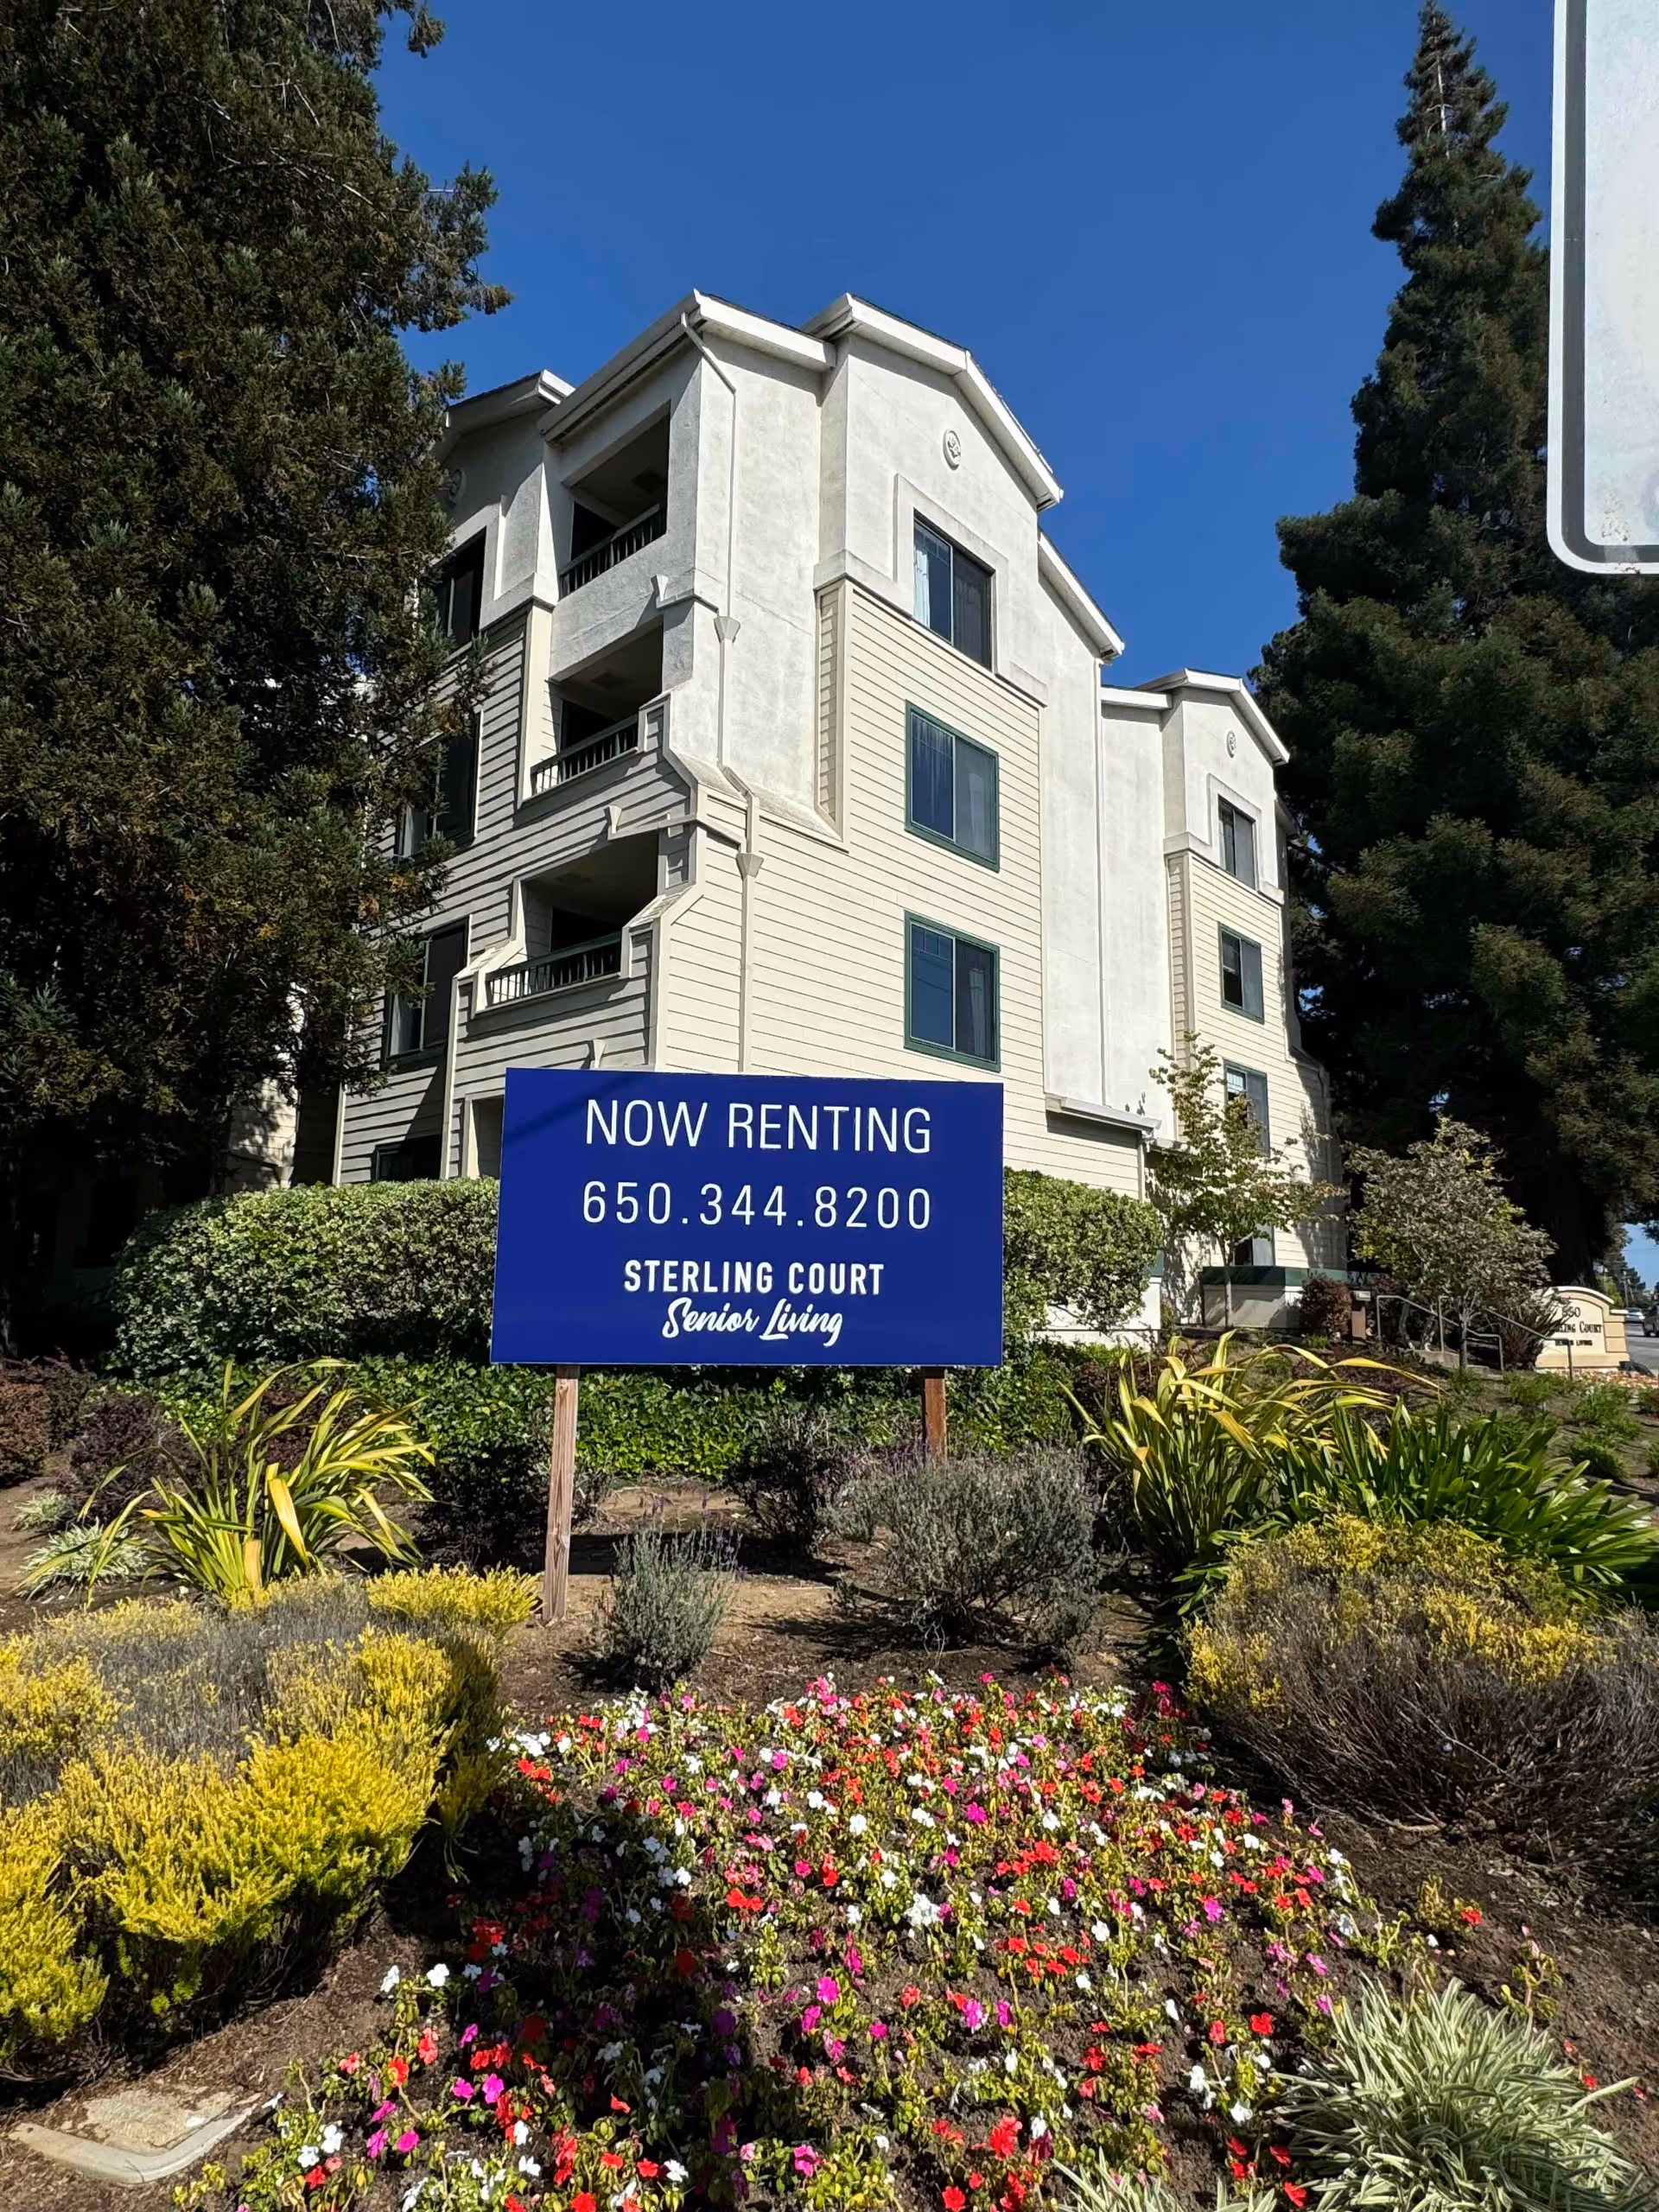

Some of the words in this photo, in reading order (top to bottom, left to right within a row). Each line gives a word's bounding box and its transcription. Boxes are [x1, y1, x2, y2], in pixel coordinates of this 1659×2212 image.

[587, 1099, 709, 1147] NOW
[728, 1103, 931, 1154] RENTING
[583, 1180, 931, 1230] 650.344.8200
[624, 1259, 774, 1294] STERLING
[788, 1262, 885, 1295] COURT
[662, 1297, 760, 1338] Senior
[759, 1299, 843, 1348] Living
